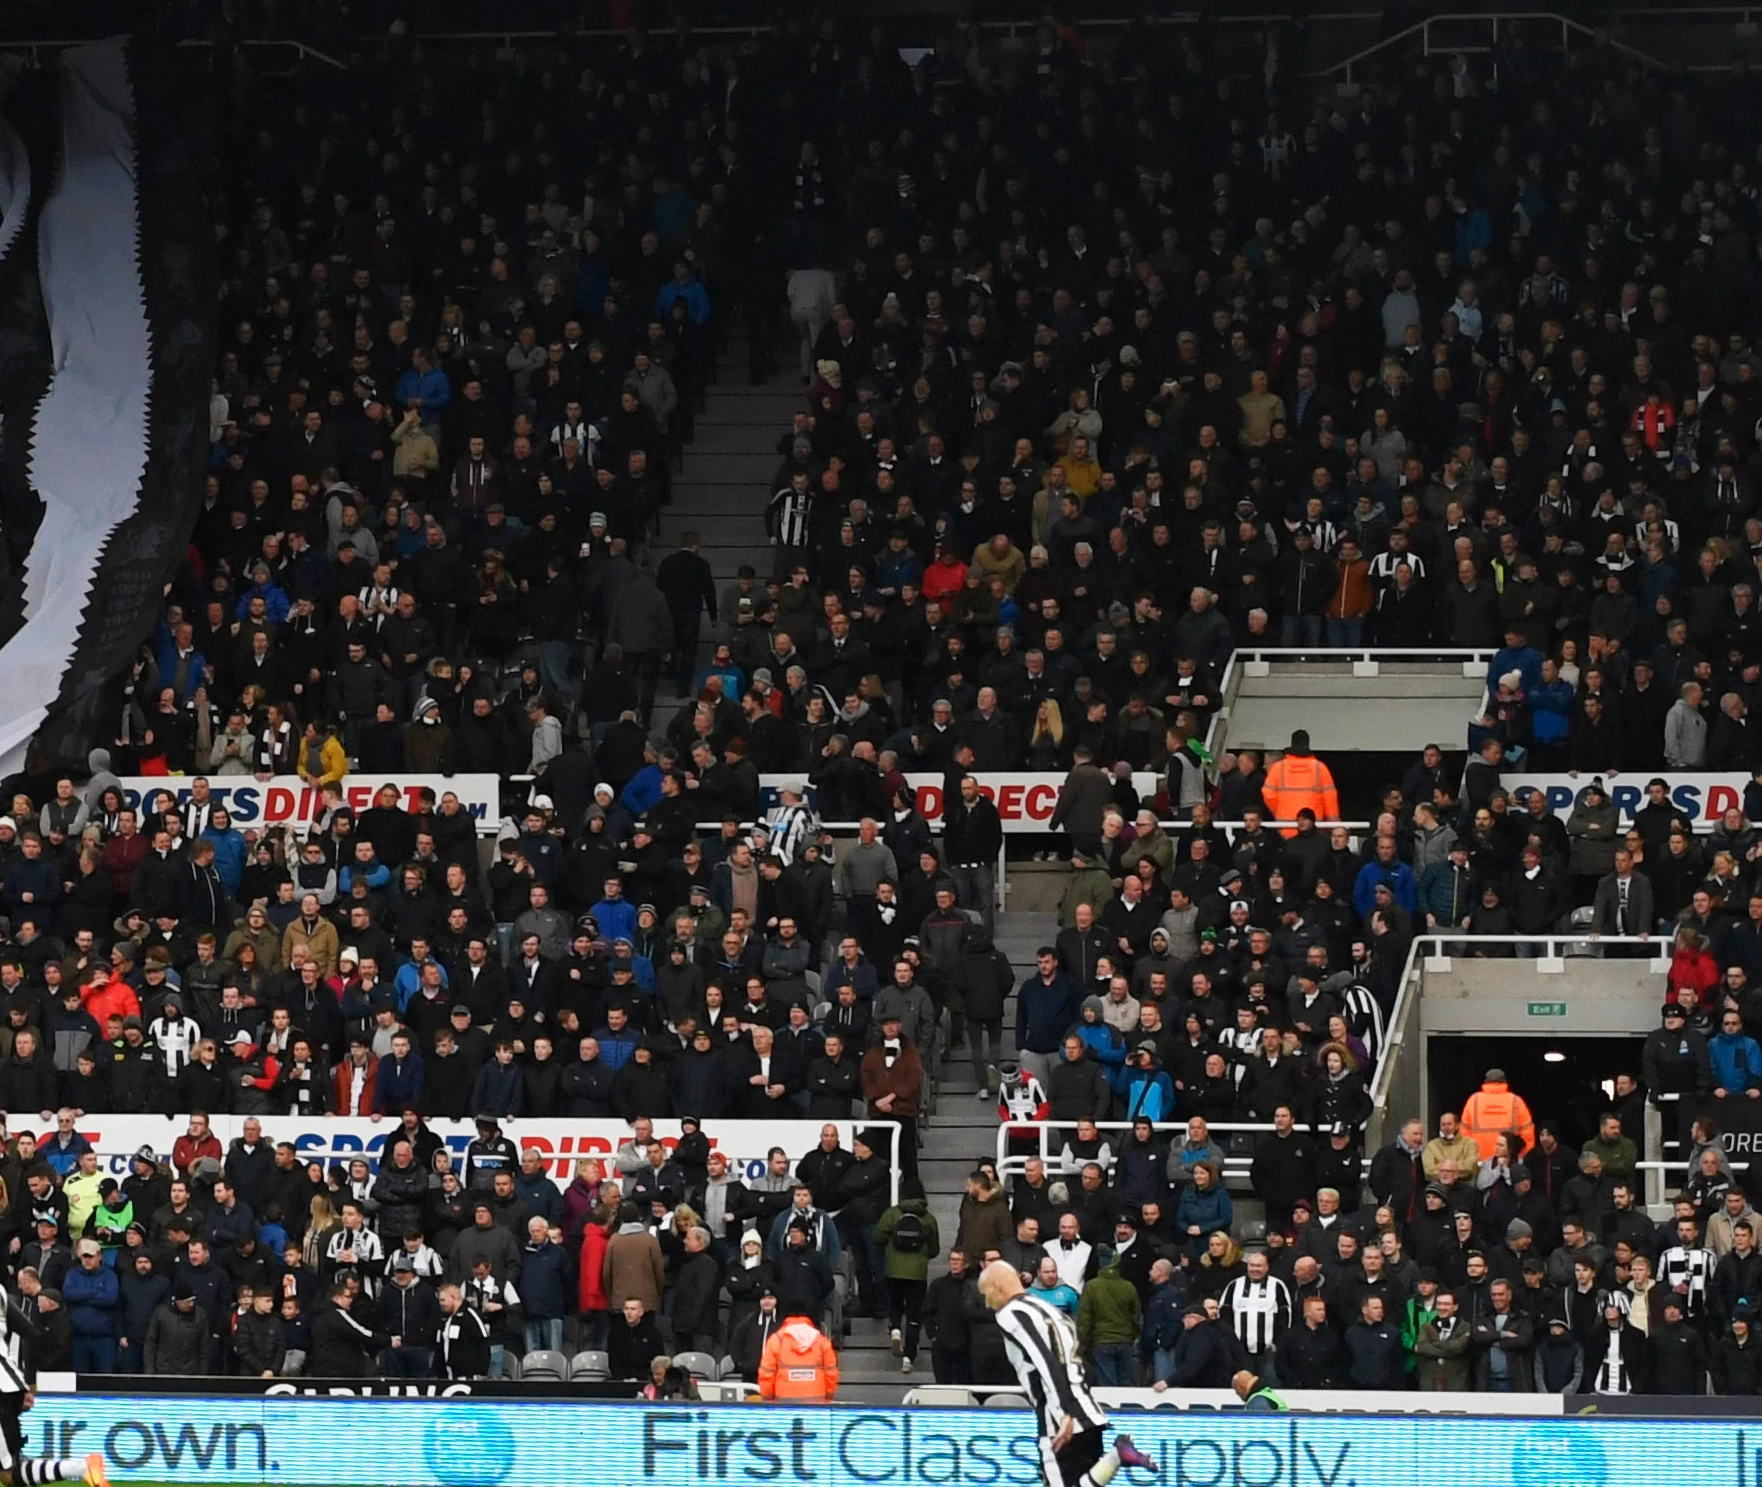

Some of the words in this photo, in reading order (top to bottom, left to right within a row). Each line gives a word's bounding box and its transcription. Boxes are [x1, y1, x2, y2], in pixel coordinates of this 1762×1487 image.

[103, 1420, 280, 1471] own.
[643, 1411, 817, 1480] First
[839, 1411, 1041, 1484] Class
